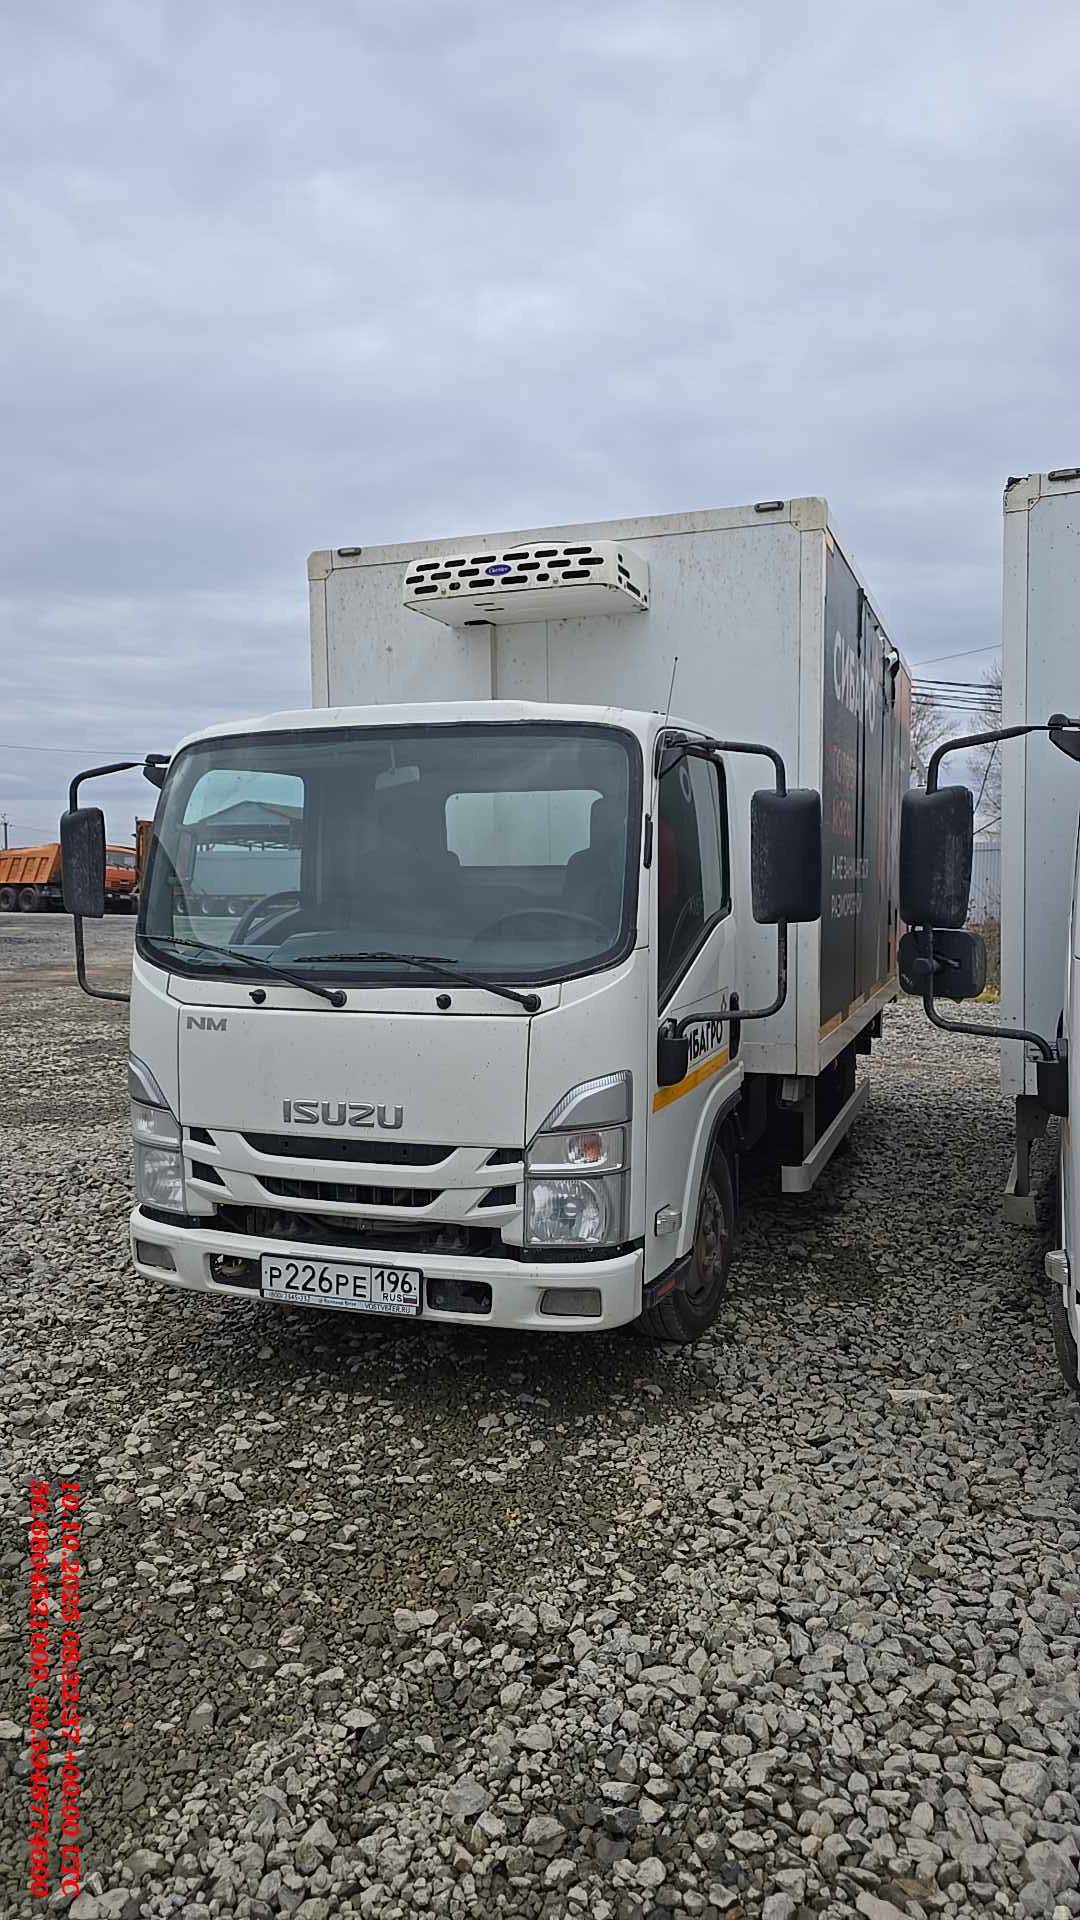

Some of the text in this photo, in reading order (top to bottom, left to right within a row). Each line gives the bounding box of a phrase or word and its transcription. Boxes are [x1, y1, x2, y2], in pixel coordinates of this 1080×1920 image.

[186, 1016, 228, 1032] NM
[685, 1019, 723, 1061] ИБАГРО
[282, 1098, 404, 1130] ISUZU
[374, 1270, 413, 1293] 196
[382, 1292, 403, 1302] RUS
